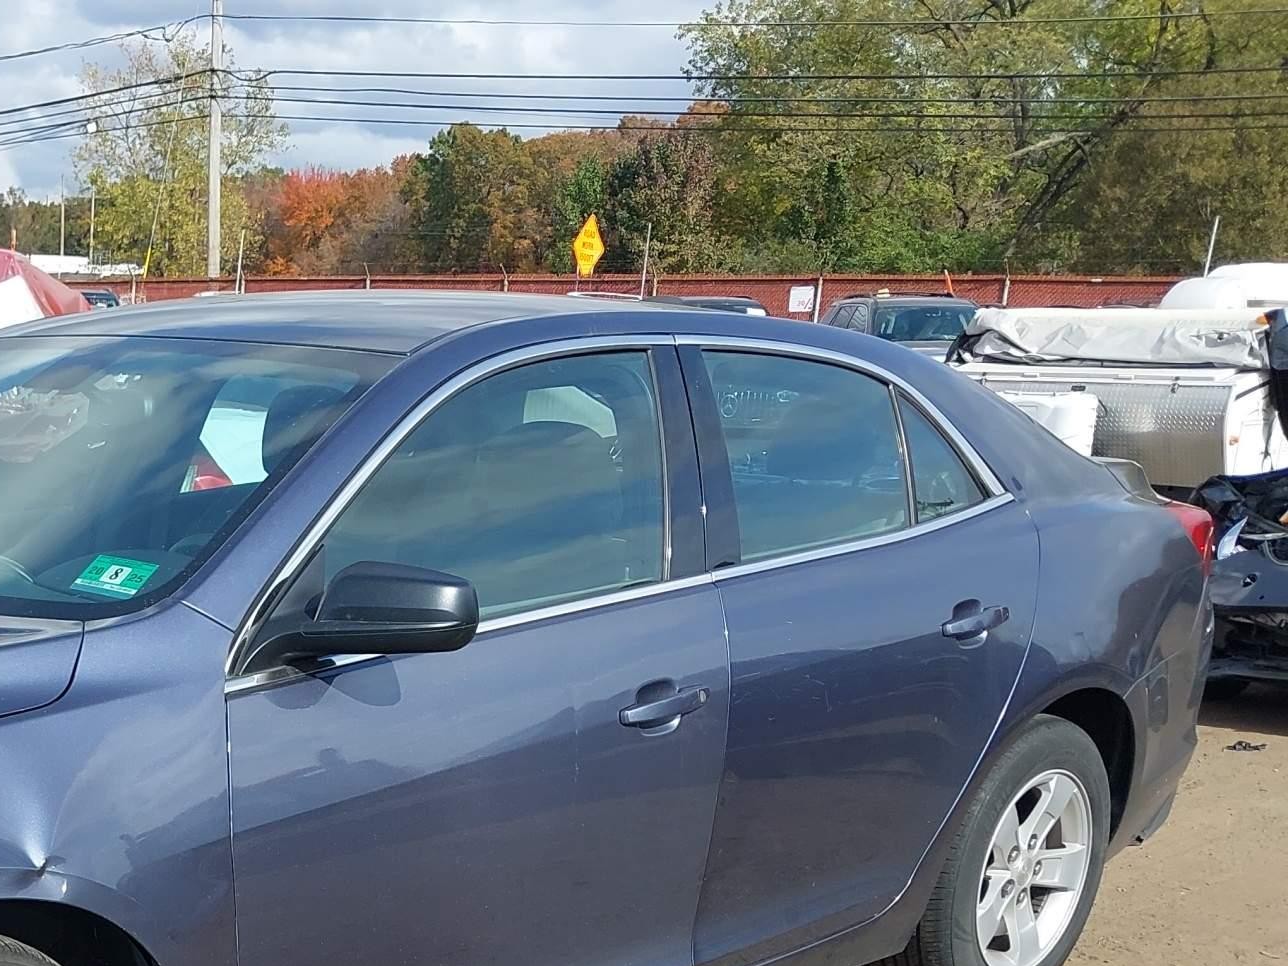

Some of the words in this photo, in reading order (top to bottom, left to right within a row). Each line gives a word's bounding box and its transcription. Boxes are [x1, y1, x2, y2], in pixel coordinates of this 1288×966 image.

[88, 566, 105, 576] 20
[109, 568, 123, 580] 8
[127, 574, 145, 583] 25
